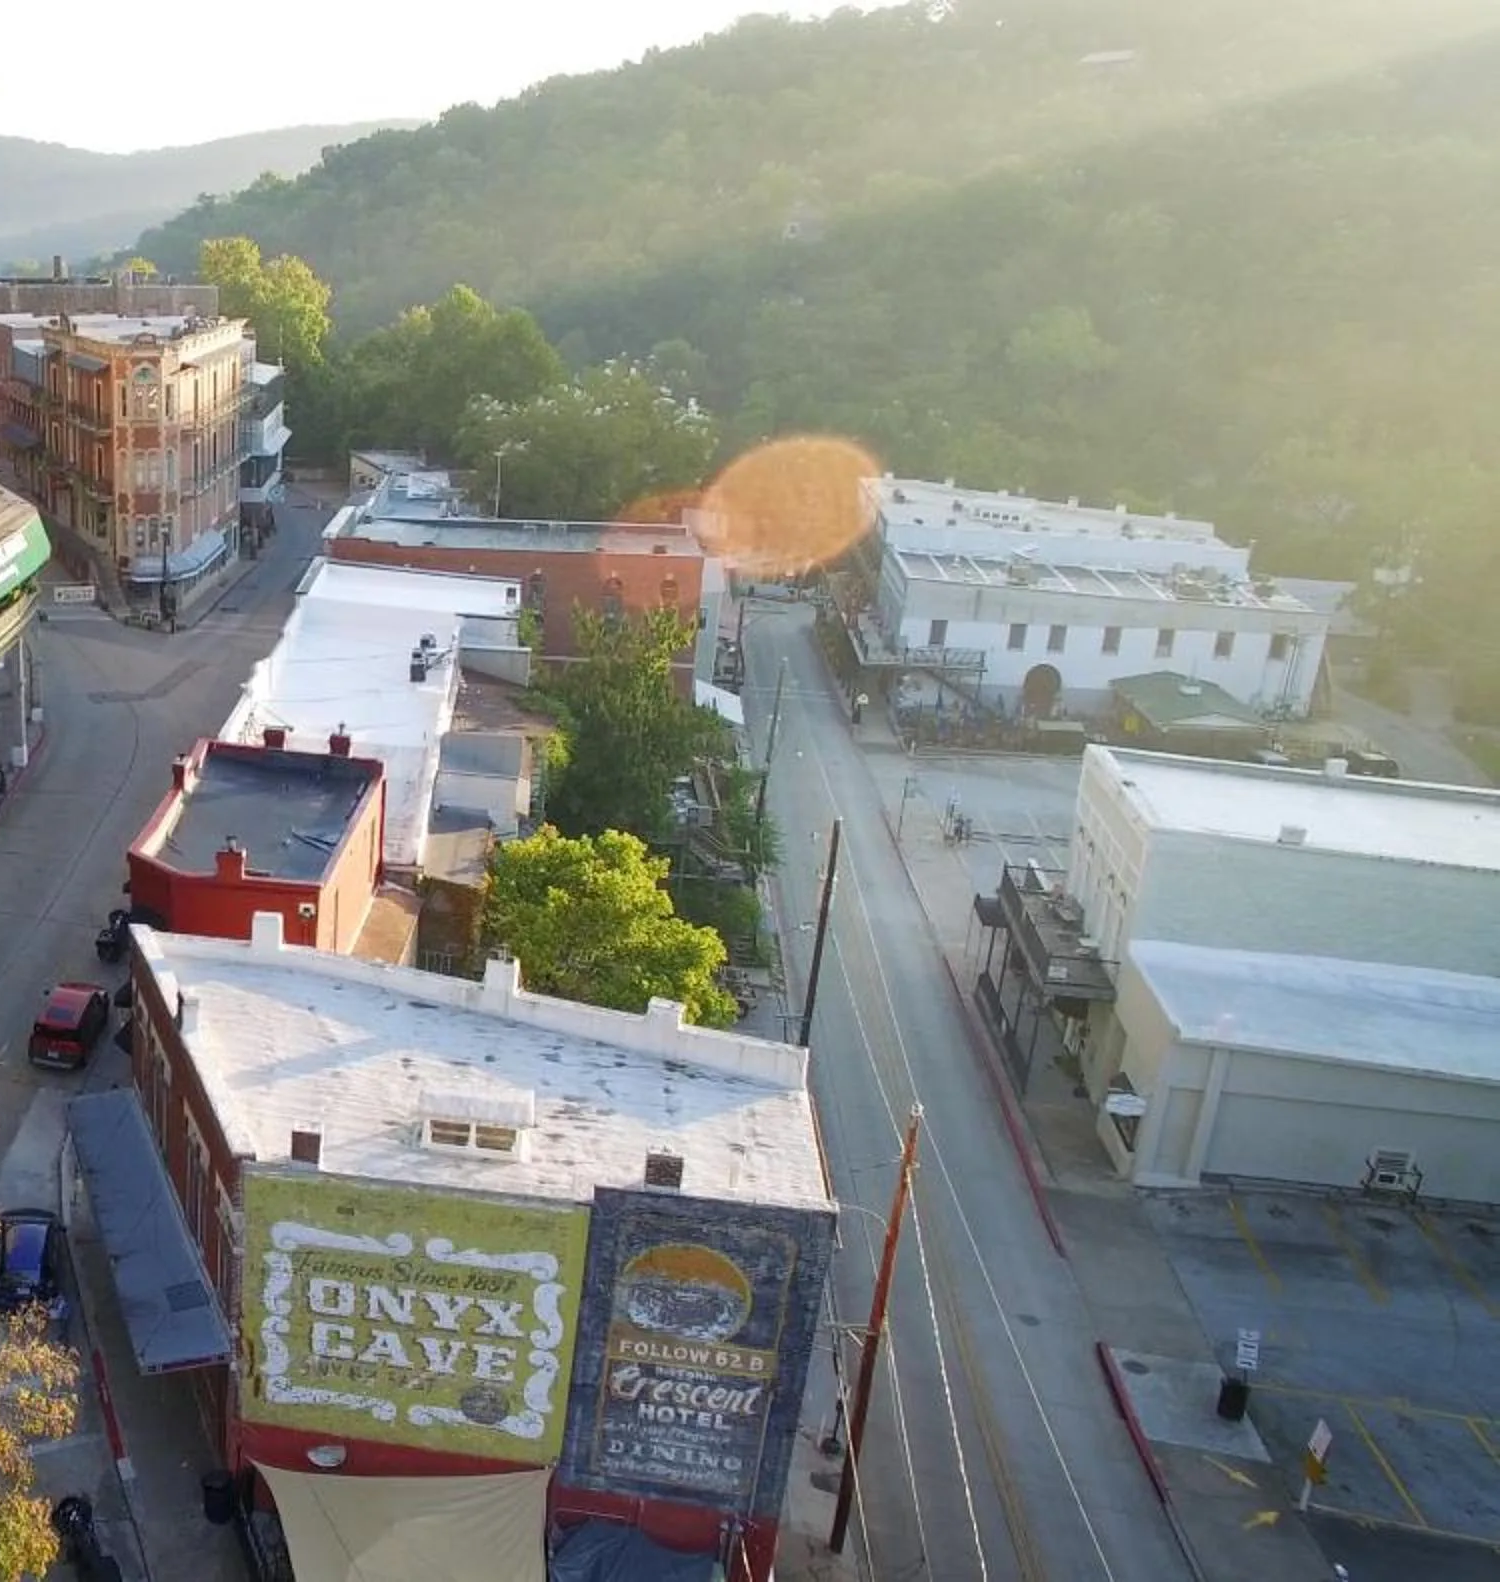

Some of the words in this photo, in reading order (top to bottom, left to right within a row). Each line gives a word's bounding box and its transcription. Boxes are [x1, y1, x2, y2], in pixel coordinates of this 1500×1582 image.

[294, 1250, 383, 1281] Famous
[392, 1260, 459, 1290] Since
[307, 1278, 524, 1338] ONYX
[311, 1321, 517, 1382] CAVE
[619, 1339, 710, 1364] FOLLOW
[715, 1351, 743, 1369] 62
[610, 1362, 764, 1416] Crescent
[638, 1402, 733, 1430] HOTEL
